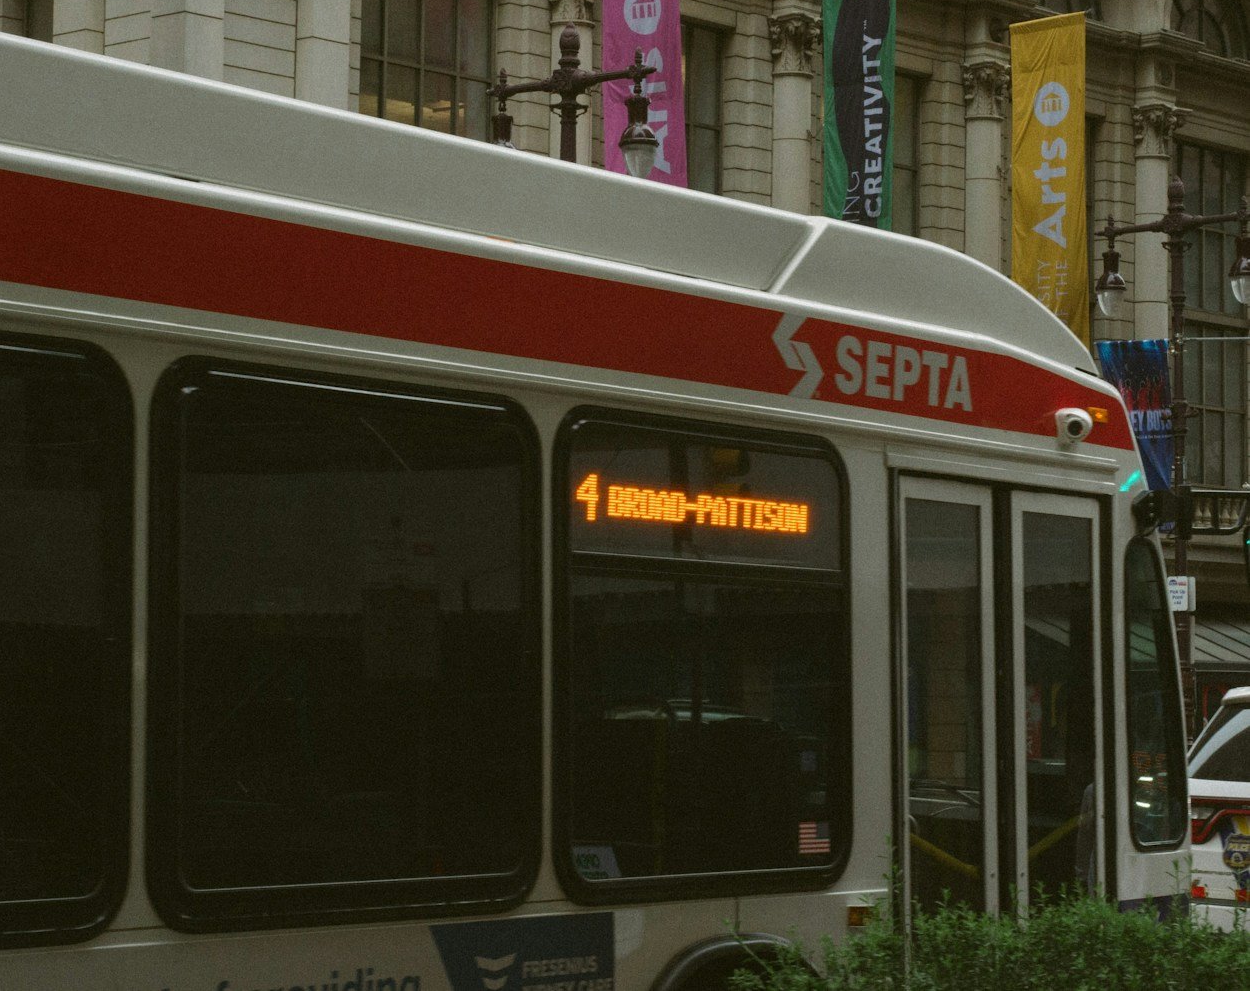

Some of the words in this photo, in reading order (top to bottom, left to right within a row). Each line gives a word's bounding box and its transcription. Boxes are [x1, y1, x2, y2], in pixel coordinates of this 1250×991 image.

[1031, 136, 1068, 249] Arts
[834, 335, 973, 412] SEPTA
[576, 474, 599, 521] 4
[522, 955, 598, 978] FRESENIUS
